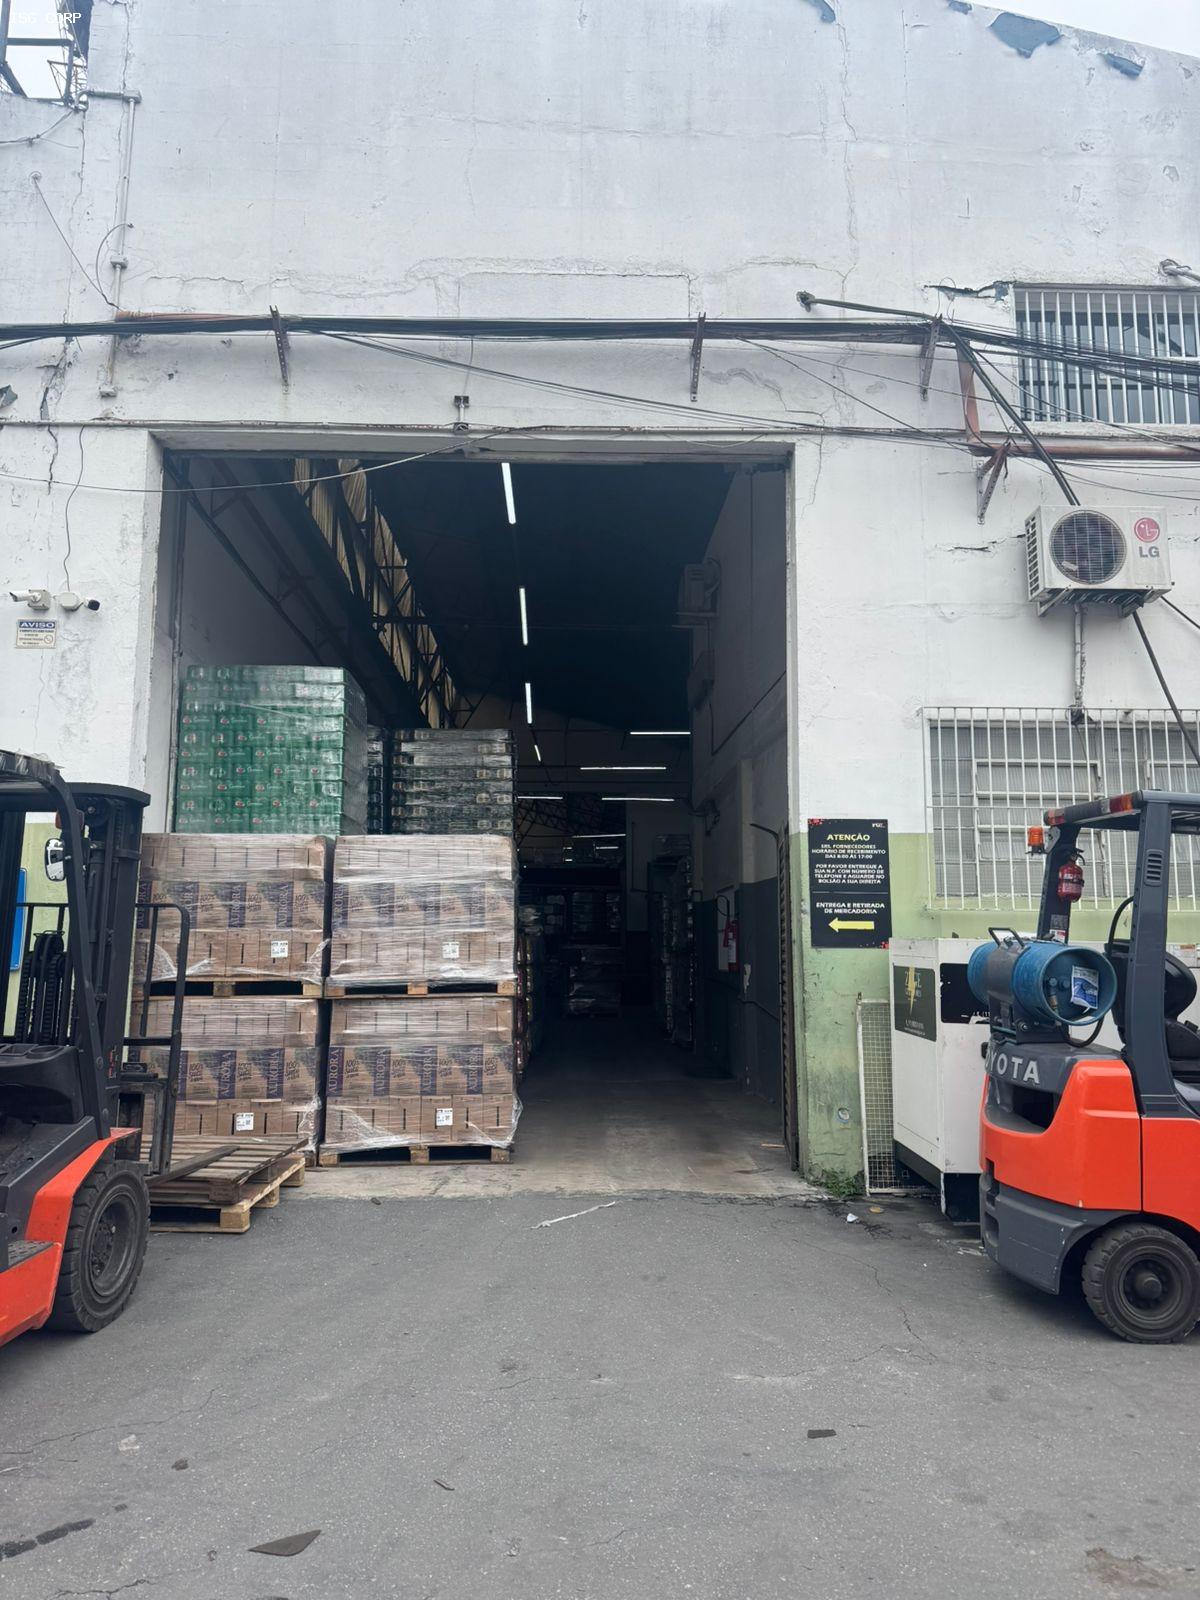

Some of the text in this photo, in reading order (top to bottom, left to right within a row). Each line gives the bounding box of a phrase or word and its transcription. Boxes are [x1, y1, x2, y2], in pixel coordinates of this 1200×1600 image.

[1138, 546, 1160, 558] LG
[827, 833, 870, 842] ATENÇÃO
[232, 885, 241, 928] AURORA
[279, 885, 289, 928] AURORA
[221, 1052, 232, 1094] AURORA
[269, 1051, 280, 1094] AURORA
[329, 1048, 340, 1094] AURORA
[376, 1048, 387, 1093] AURORA
[469, 1047, 481, 1090] AURORA
